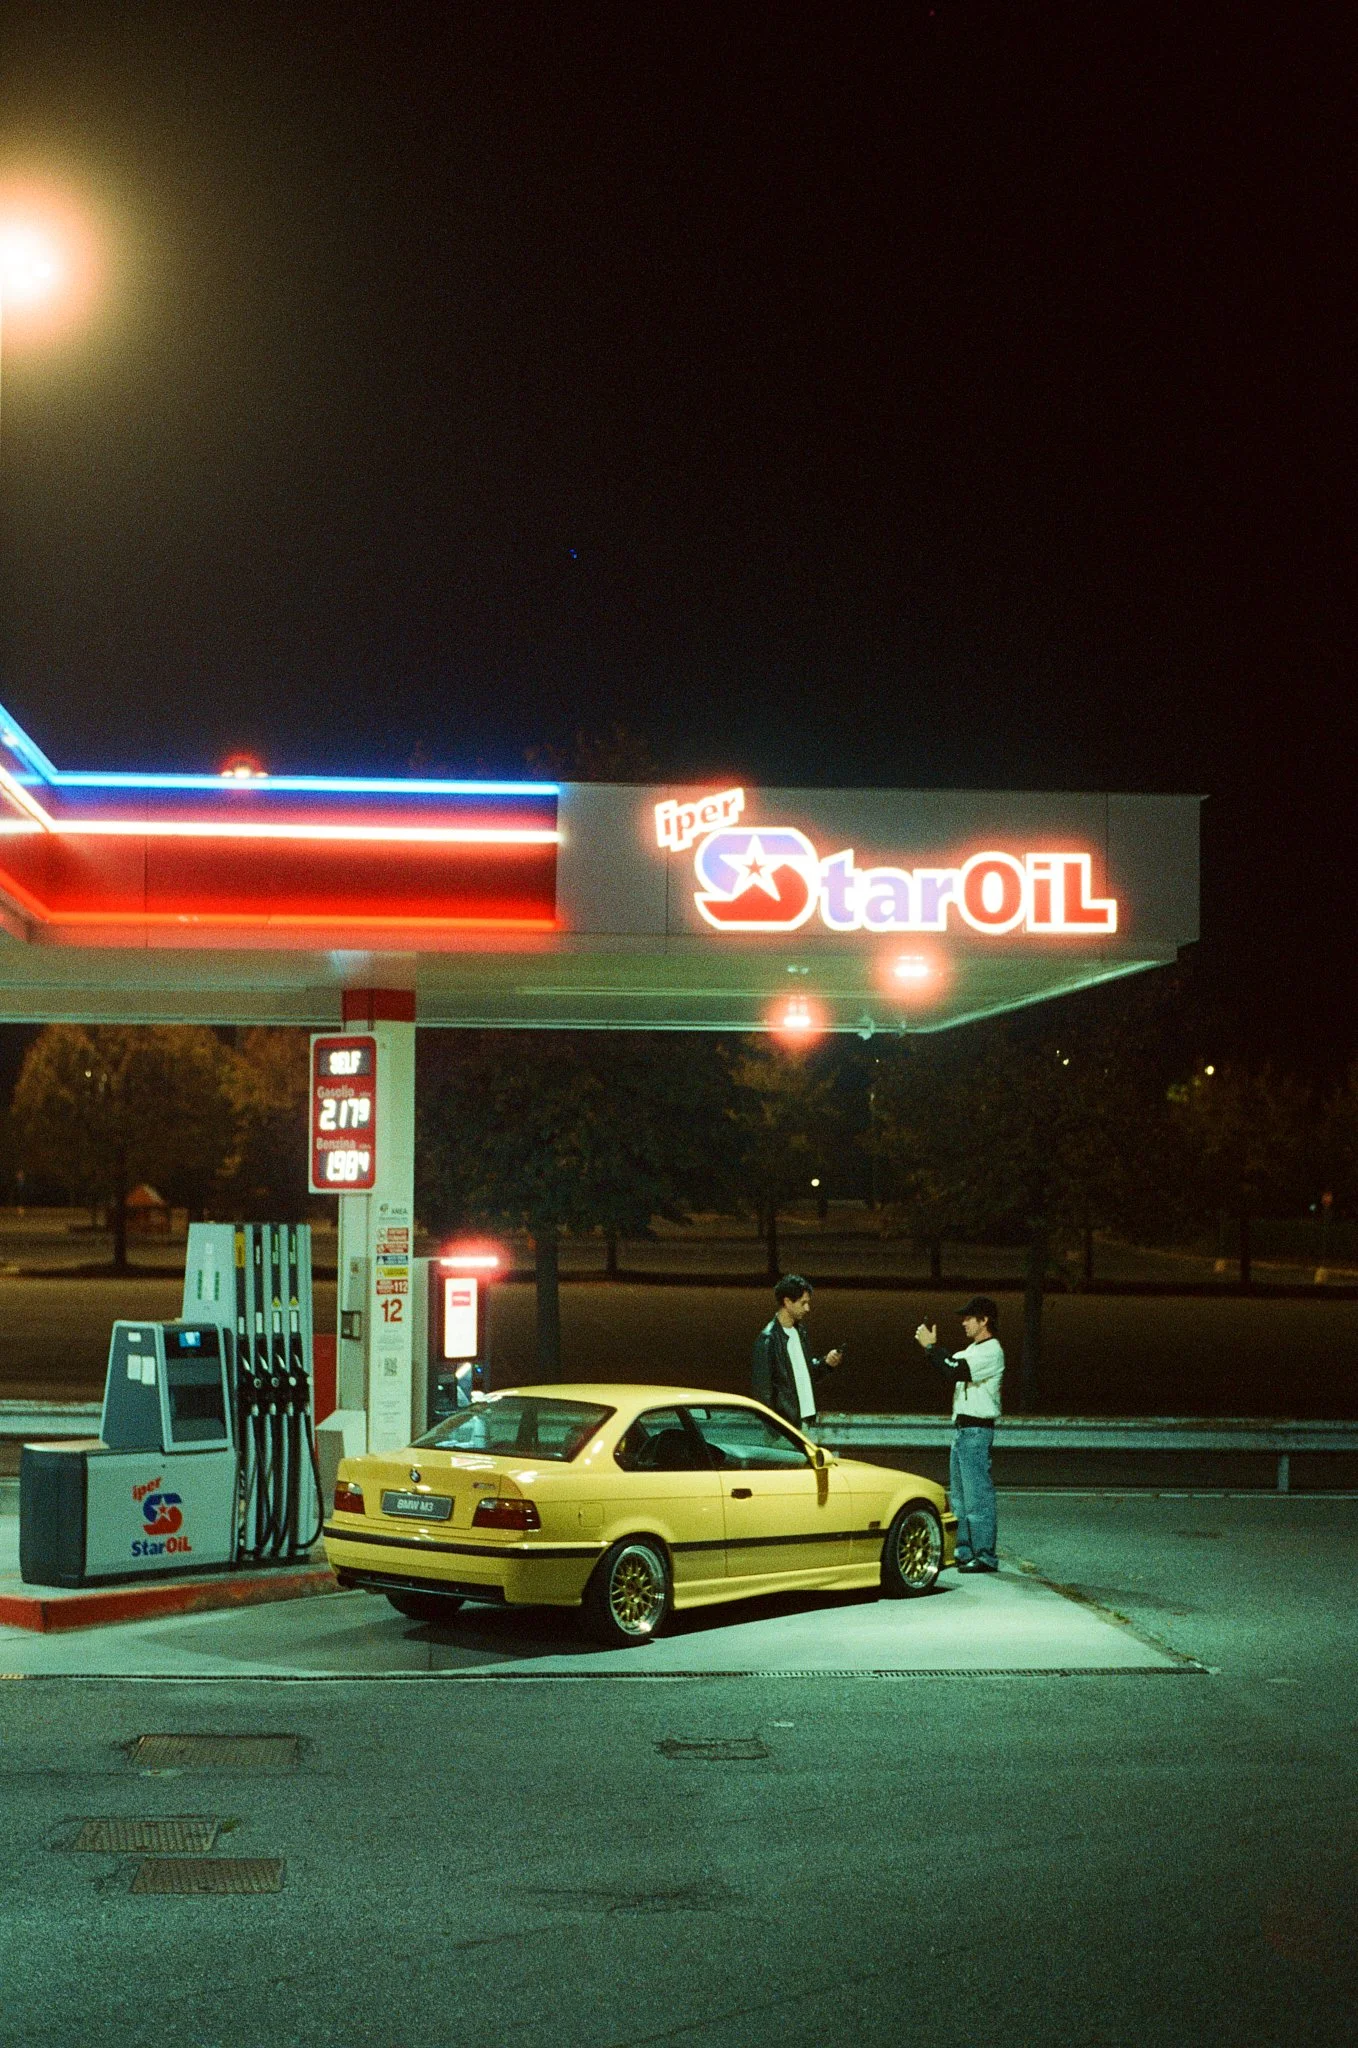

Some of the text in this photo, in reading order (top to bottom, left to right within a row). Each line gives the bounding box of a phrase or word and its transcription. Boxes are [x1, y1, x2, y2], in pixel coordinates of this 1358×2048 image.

[658, 790, 744, 851] iper
[330, 1050, 361, 1075] SELF
[316, 1137, 356, 1150] Benzina
[394, 1281, 408, 1293] 112
[381, 1298, 403, 1323] 12
[133, 1476, 161, 1501] iper
[397, 1499, 433, 1511] BMW M3
